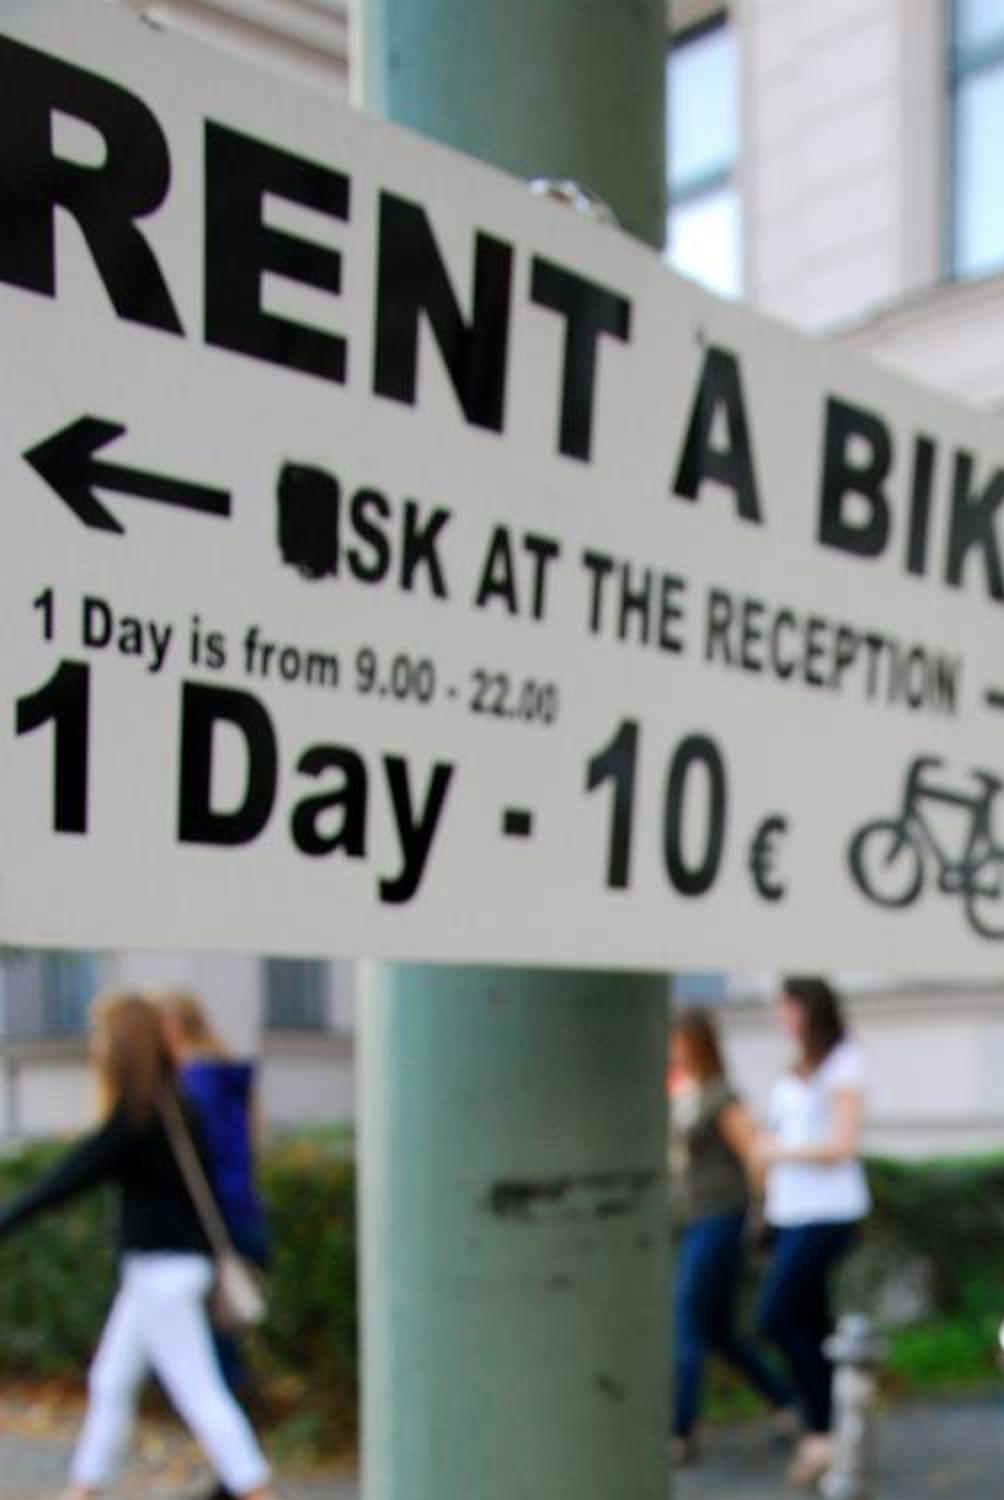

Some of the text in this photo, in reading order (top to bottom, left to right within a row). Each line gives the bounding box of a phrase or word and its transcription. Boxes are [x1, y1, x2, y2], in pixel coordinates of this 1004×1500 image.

[0, 34, 632, 464] RENT
[673, 343, 763, 525] A
[33, 588, 54, 642] 1
[83, 595, 172, 674] Day
[189, 615, 227, 670] is
[244, 625, 339, 689] from
[355, 646, 435, 704] 9.00
[468, 667, 560, 726] 22.00
[277, 460, 962, 714] SK AT THE RECEPTION
[16, 659, 90, 835] 1
[177, 680, 455, 906] Day
